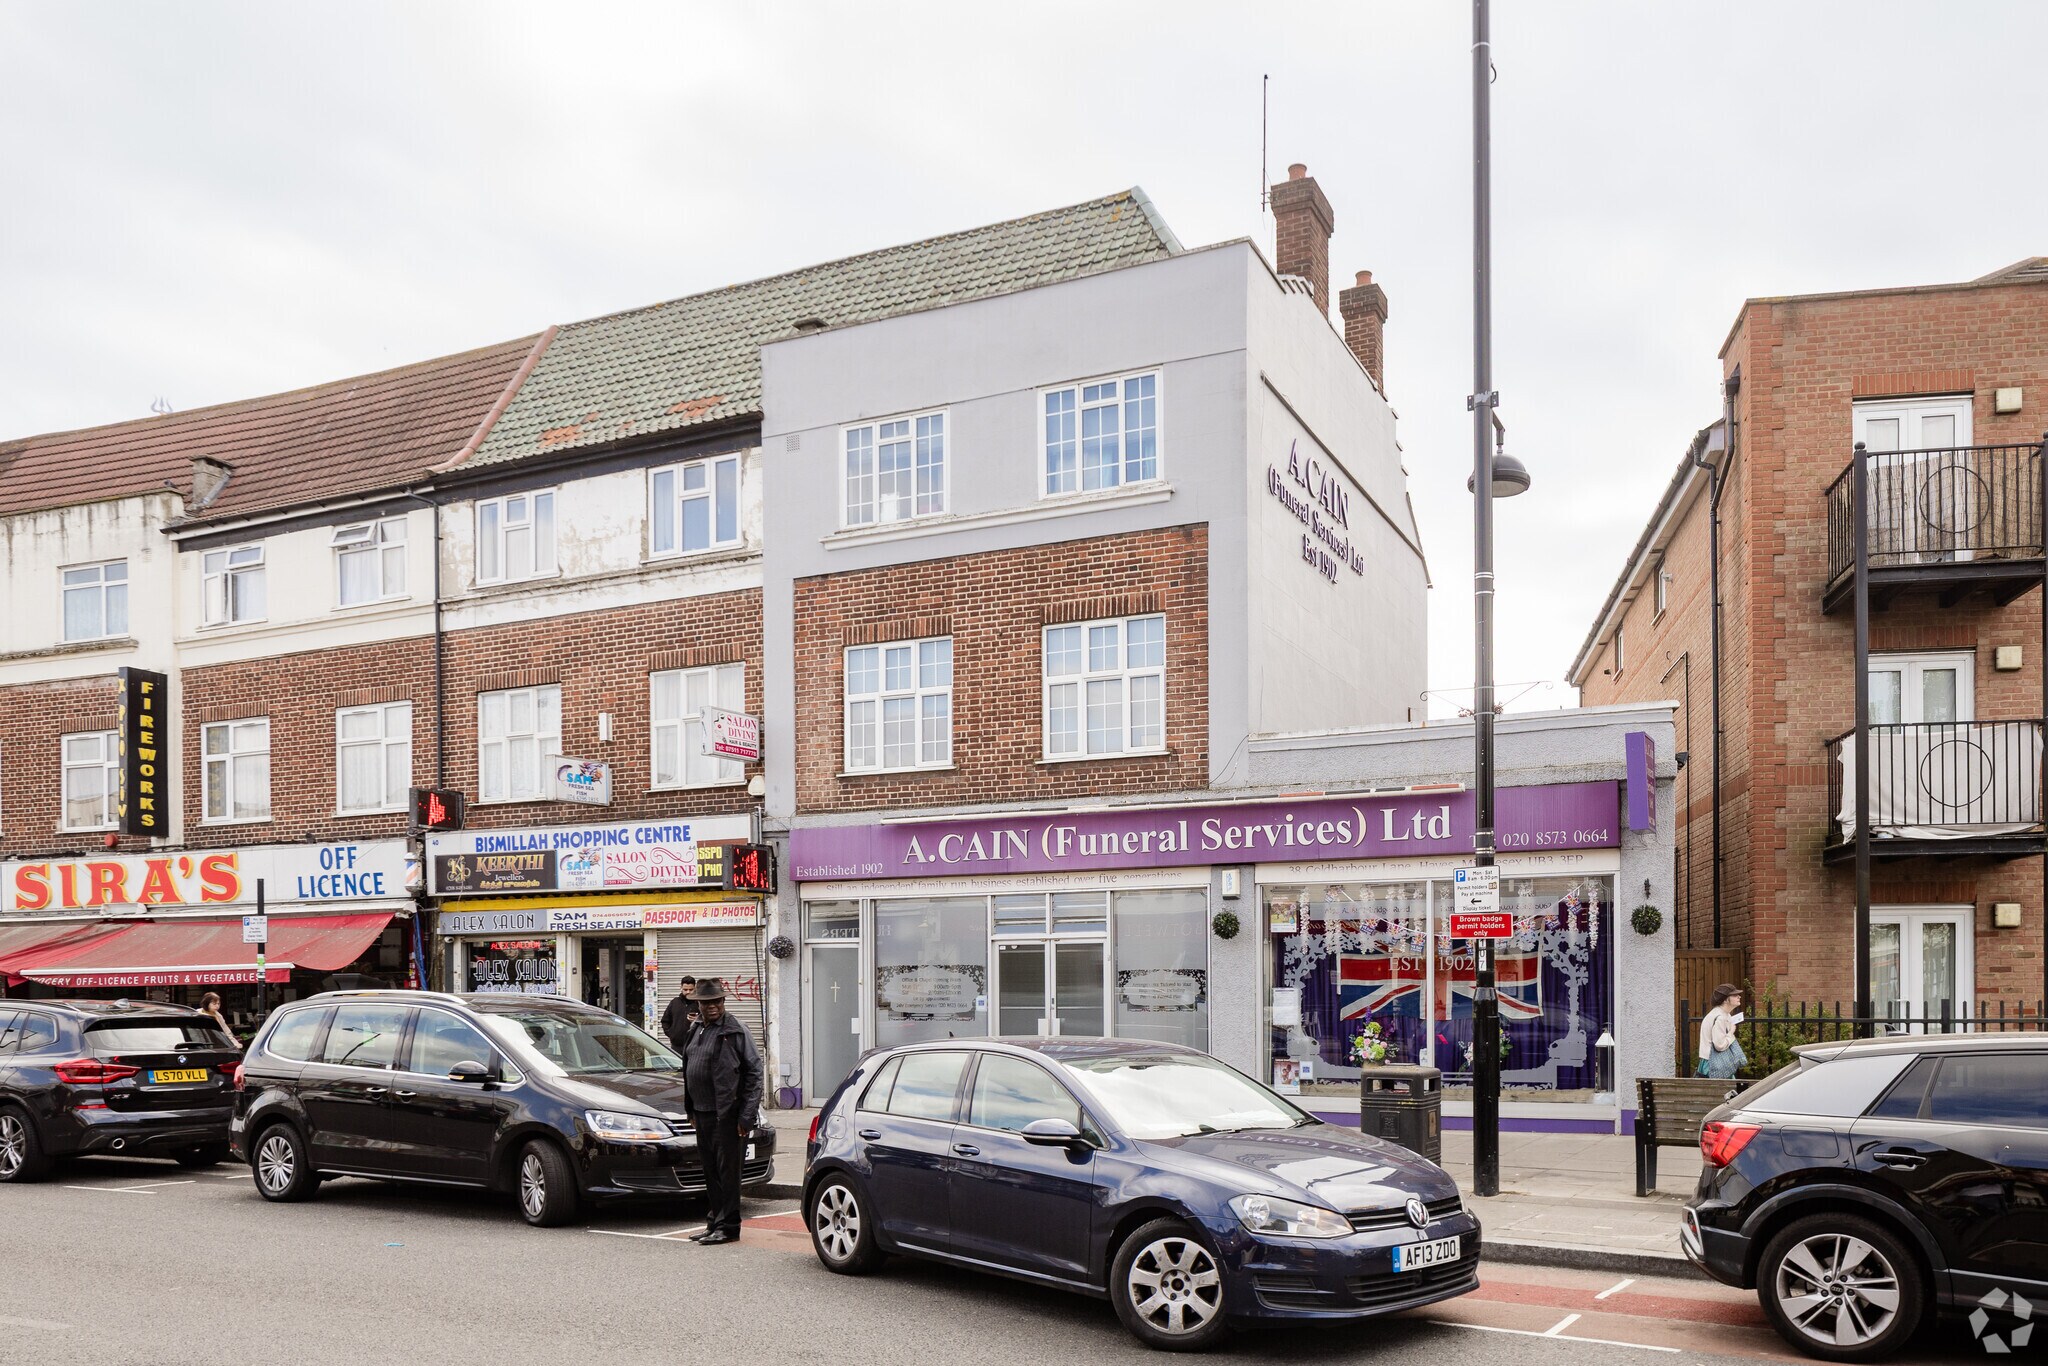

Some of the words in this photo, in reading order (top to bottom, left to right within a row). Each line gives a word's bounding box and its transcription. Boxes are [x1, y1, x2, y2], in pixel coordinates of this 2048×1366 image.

[727, 714, 757, 730] SALON
[728, 727, 757, 741] DIVINE
[138, 681, 156, 827] FIREWORKS
[567, 773, 592, 785] SAM
[476, 833, 548, 852] BISMILLAH
[554, 828, 630, 849] SHOPPING
[635, 825, 692, 844] CENTRE
[902, 828, 1032, 864] A.CAIN
[1041, 820, 1189, 862] (Funeral
[1201, 806, 1367, 851] Services)
[1380, 805, 1453, 842] Ltd
[1503, 832, 1530, 847] 020
[1536, 831, 1567, 845] 8573
[1573, 829, 1609, 843] 0664
[319, 846, 357, 870] OFF
[475, 853, 545, 876] KEERTHI
[567, 860, 591, 870] SAM
[606, 851, 647, 864] SALON
[651, 865, 696, 877] DIVINE
[796, 864, 856, 877] Established
[861, 863, 883, 875] 1902
[15, 851, 242, 911] SIRA'S
[298, 872, 386, 898] LICENCE
[494, 874, 525, 882] Jewellers
[861, 881, 914, 890] independent
[918, 880, 947, 890] family
[971, 877, 1012, 888] business
[1015, 874, 1070, 887] established
[1073, 875, 1095, 884] over
[1099, 873, 1118, 883] five
[452, 916, 485, 931] ALEX
[493, 914, 534, 930] SALON
[552, 912, 587, 921] SAM
[644, 909, 697, 925] PASSPORT
[702, 907, 708, 918] &
[711, 907, 720, 918] ID
[722, 905, 756, 917] PHOTOS
[1482, 915, 1503, 923] badge
[550, 922, 588, 930] FRESH
[590, 921, 614, 929] SEA
[615, 920, 642, 929] FISH
[490, 941, 509, 950] ALEX
[473, 959, 510, 981] ALEX
[515, 959, 557, 981] SALON
[1389, 956, 1423, 971] EST
[1439, 956, 1475, 971] 1902
[76, 976, 140, 986] OFF-LICENCE
[144, 975, 179, 984] FRUITS
[184, 974, 190, 983] &
[155, 1071, 183, 1081] LS70
[186, 1070, 205, 1080] VLL
[1406, 1245, 1432, 1266] AF13
[1436, 1239, 1456, 1260] ZDO
